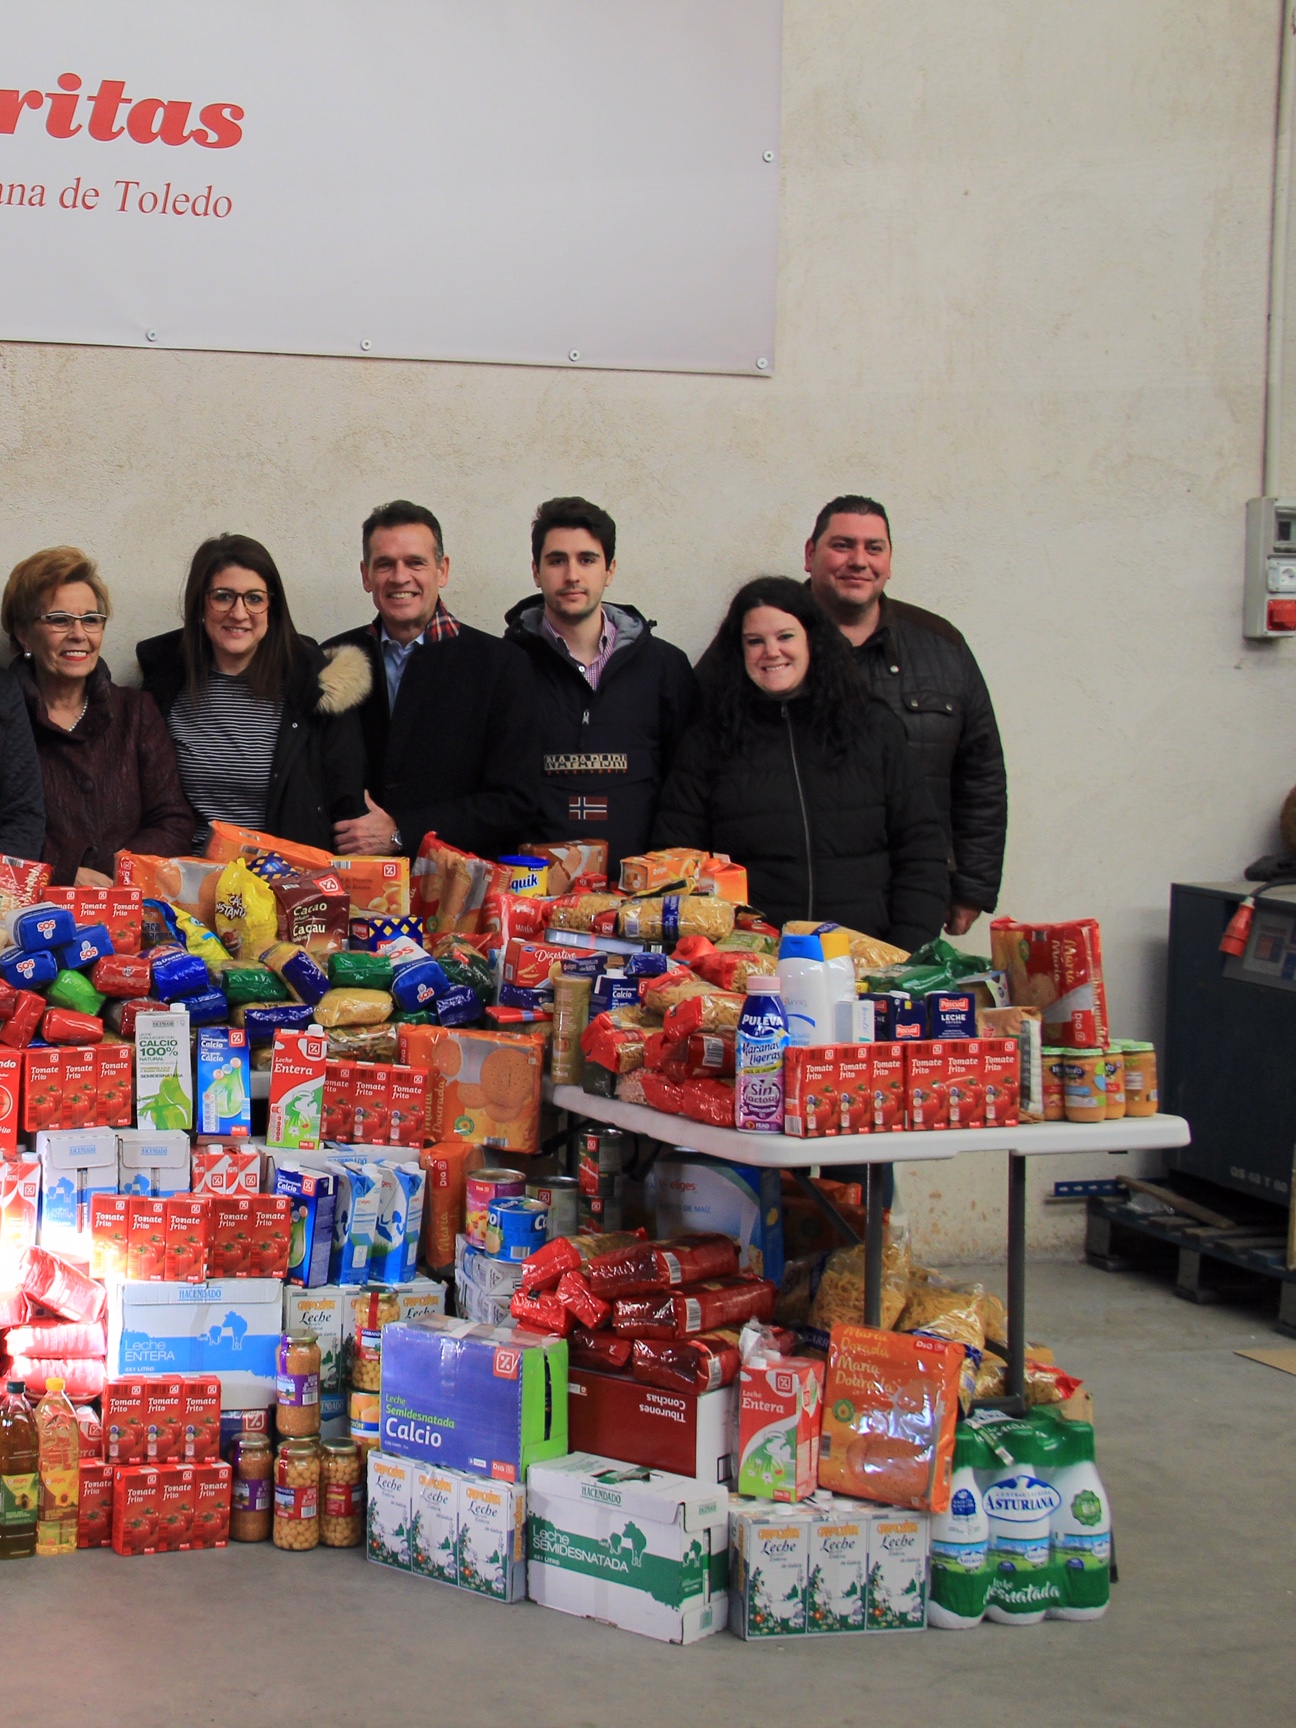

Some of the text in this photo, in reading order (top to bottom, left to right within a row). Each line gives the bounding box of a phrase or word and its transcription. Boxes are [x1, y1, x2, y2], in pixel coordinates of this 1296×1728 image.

[58, 176, 100, 212] de
[114, 180, 233, 220] Toledo
[293, 902, 327, 917] Cacao
[38, 921, 56, 931] SOS
[292, 923, 326, 937] Cacau
[80, 947, 98, 960] SOS
[388, 946, 414, 960] OS
[17, 960, 34, 971] SOS
[742, 1014, 783, 1026] PULEVA
[201, 1041, 223, 1049] Calcio
[139, 1047, 178, 1057] 100%
[201, 1053, 224, 1062] Cálcio
[66, 1065, 93, 1073] Tomate
[274, 1064, 313, 1076] Entera
[840, 1063, 867, 1072] Tomate
[324, 1080, 349, 1088] omate
[392, 1085, 422, 1095] Tomate
[751, 1084, 772, 1095] Sin
[277, 1181, 297, 1193] Calcio
[670, 1180, 697, 1192] eliges
[132, 1215, 162, 1224] Tomate
[256, 1211, 285, 1220] Tomate
[178, 1288, 222, 1300] HACENDADO
[300, 1311, 332, 1325] Leche
[125, 1338, 166, 1350] Leche
[125, 1350, 175, 1362] ENTERA
[385, 1394, 406, 1406] Leche
[742, 1390, 762, 1398] Leche
[110, 1398, 140, 1406] Tomate
[646, 1394, 686, 1410] Conchas
[742, 1398, 784, 1414] Entera
[385, 1404, 455, 1429] Semidesnatada
[639, 1403, 686, 1423] Tiburones
[385, 1417, 442, 1448] Calcio
[84, 1480, 112, 1488] Tomate
[376, 1475, 402, 1491] Leche
[420, 1488, 448, 1504] Leche
[582, 1486, 622, 1504] HACENDADO
[468, 1500, 497, 1517] Leche
[987, 1495, 1054, 1510] ASTURIANA
[533, 1524, 570, 1544] Leche
[761, 1540, 796, 1555] Leche
[820, 1537, 856, 1552] Leche
[880, 1535, 915, 1550] Leche
[533, 1538, 629, 1573] SEMIDESNATADA
